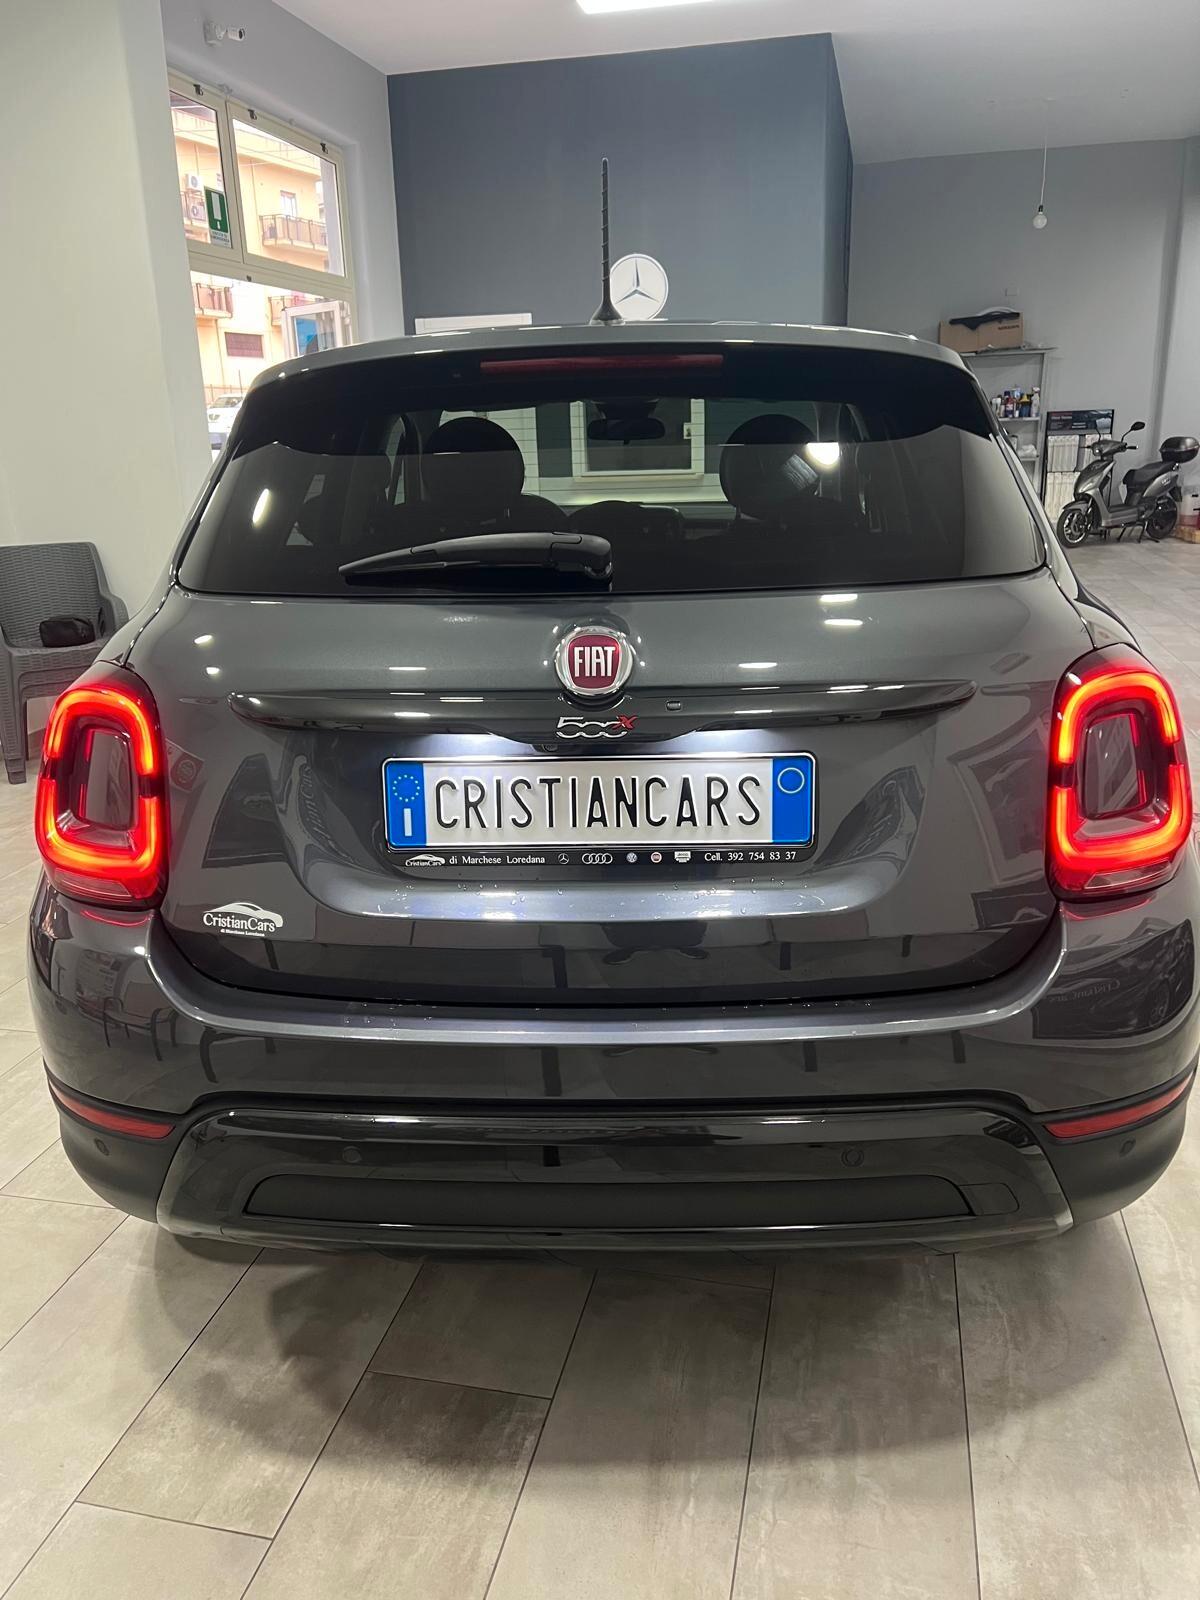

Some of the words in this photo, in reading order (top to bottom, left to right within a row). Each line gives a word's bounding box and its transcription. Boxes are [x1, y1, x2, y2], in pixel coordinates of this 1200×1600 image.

[573, 646, 616, 677] FIAT
[435, 775, 760, 829] CRISTIANCARS
[449, 855, 458, 864] di
[461, 855, 502, 864] Marchese
[506, 855, 546, 864] Loredana
[704, 852, 723, 861] Cell.
[727, 852, 744, 861] 392
[748, 851, 765, 861] 754
[769, 851, 781, 861] 83
[785, 851, 797, 860] 37
[203, 913, 275, 932] CristianCars
